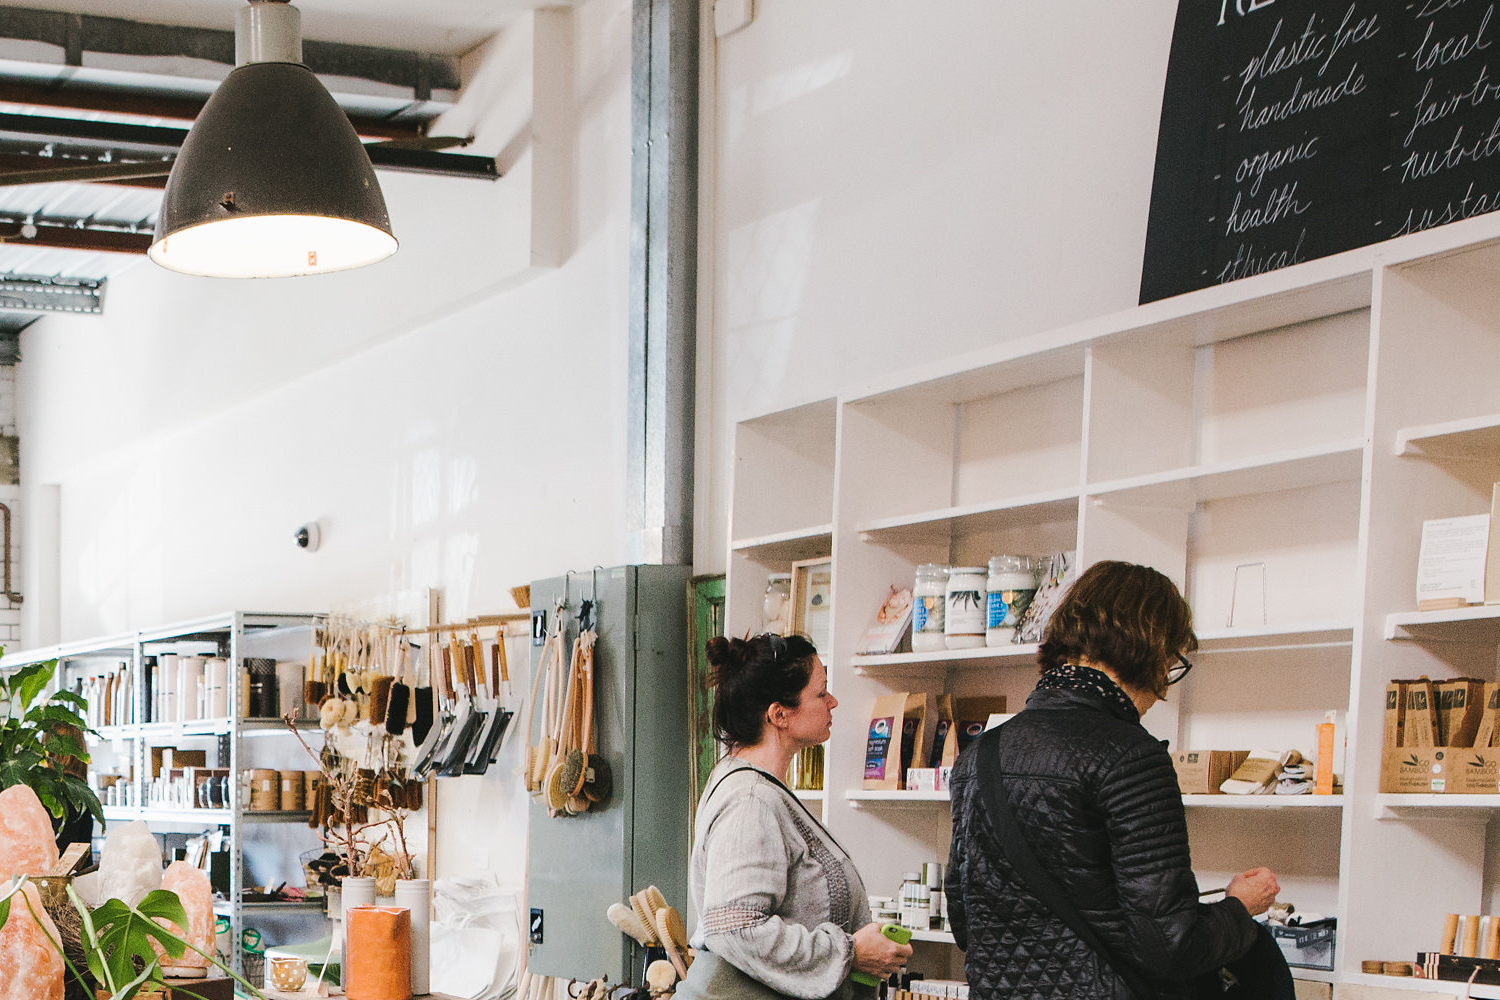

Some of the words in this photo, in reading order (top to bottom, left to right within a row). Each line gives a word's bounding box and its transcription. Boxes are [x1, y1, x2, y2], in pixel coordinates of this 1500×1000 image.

[1236, 12, 1327, 105] plastic
[1317, 2, 1381, 77] free
[1411, 3, 1495, 73] local
[1238, 62, 1367, 133] handmade
[1235, 131, 1319, 197] organic
[1225, 181, 1312, 237] health
[1216, 227, 1306, 284] ethical
